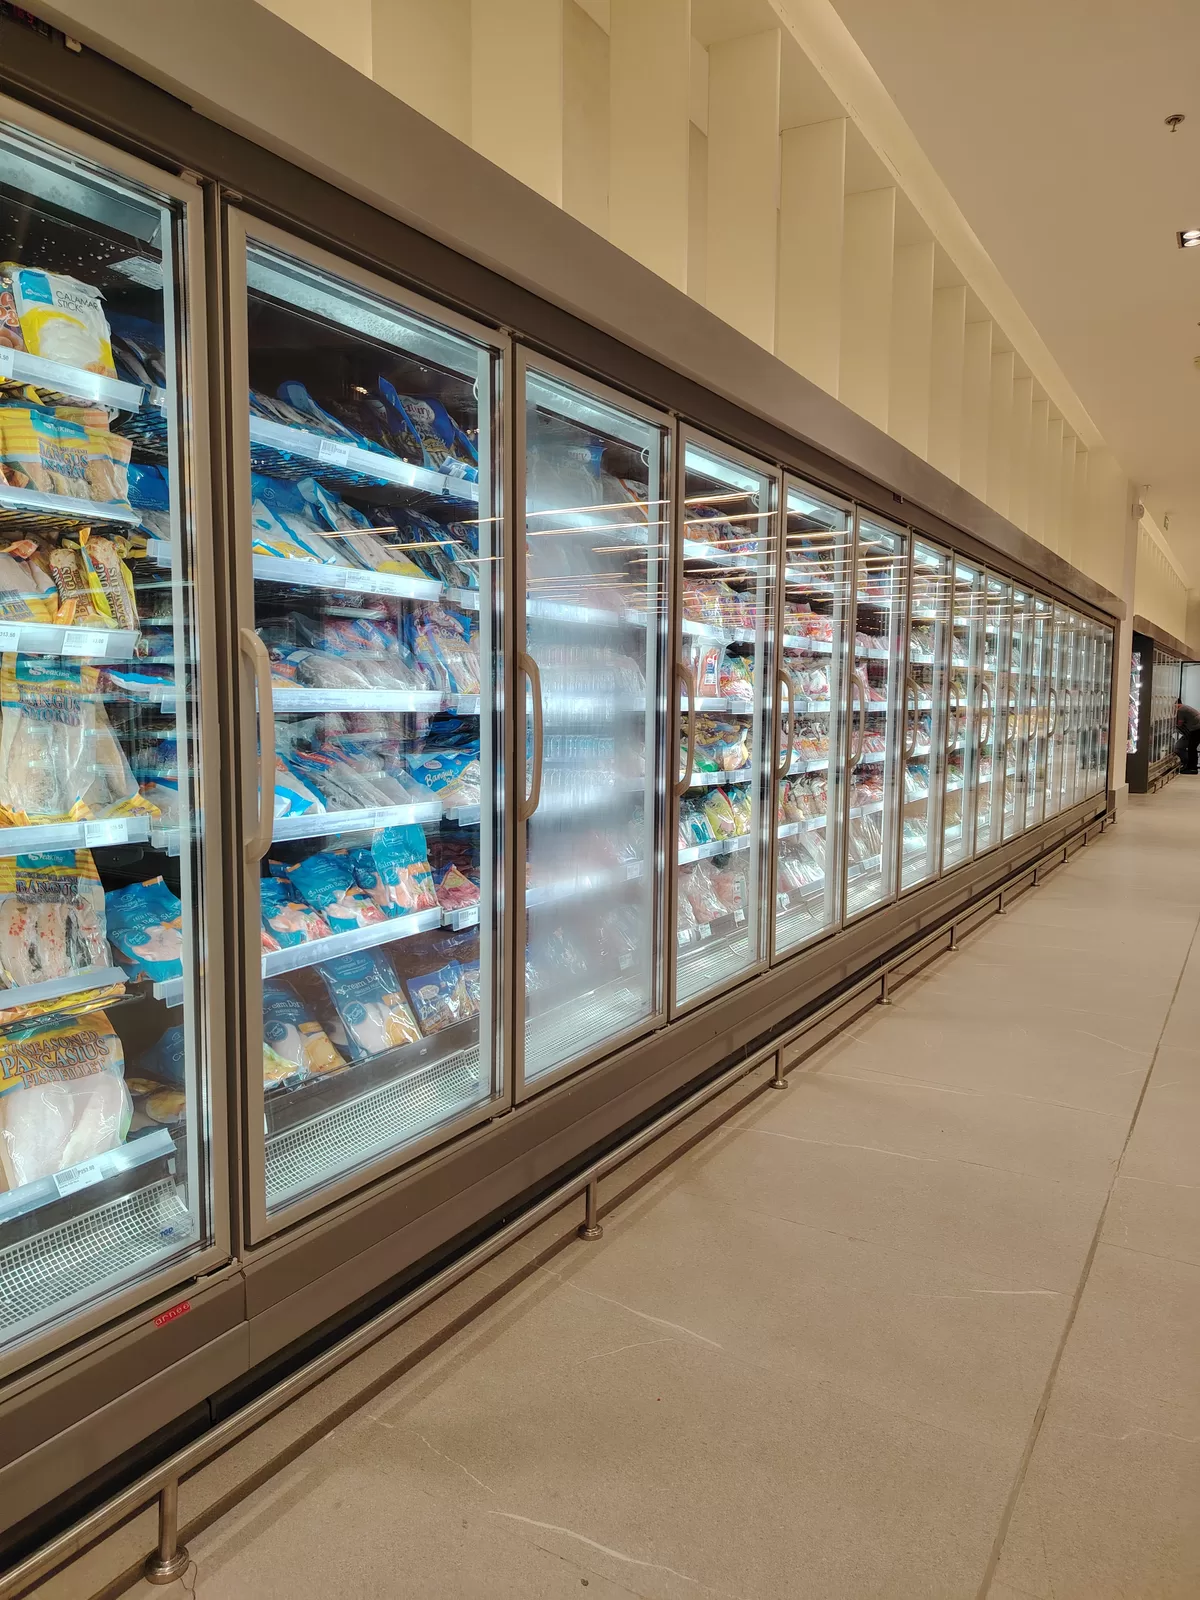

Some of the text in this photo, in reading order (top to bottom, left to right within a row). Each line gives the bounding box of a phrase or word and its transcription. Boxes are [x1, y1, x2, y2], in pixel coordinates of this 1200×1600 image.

[57, 299, 84, 313] STICKS
[15, 879, 79, 897] BANGUS
[3, 1031, 99, 1058] UNSEASONED
[1, 1038, 110, 1080] PANGASIUS
[60, 1059, 107, 1081] FILLET
